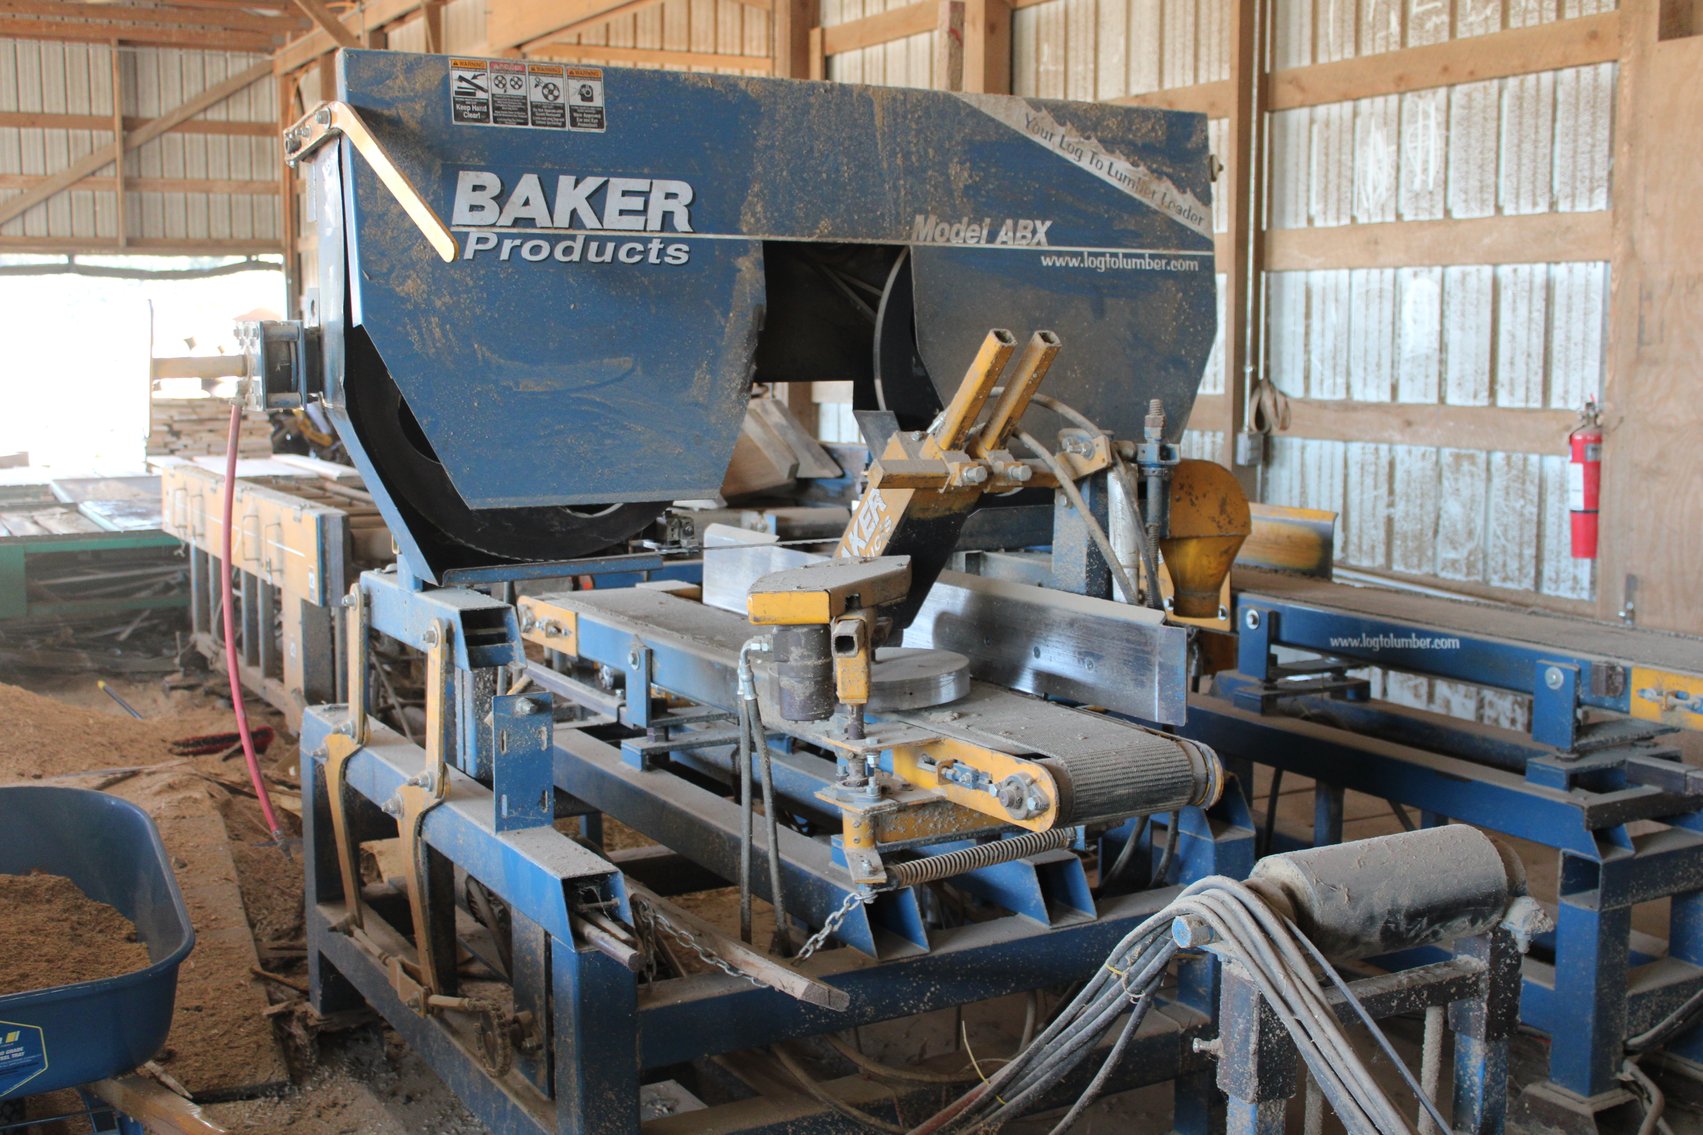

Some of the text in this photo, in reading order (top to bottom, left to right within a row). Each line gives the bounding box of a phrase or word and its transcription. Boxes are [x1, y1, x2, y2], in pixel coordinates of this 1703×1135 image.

[1024, 112, 1054, 142] Your
[1059, 134, 1084, 162] Log
[1088, 151, 1103, 171] To
[1160, 192, 1205, 226] Leader
[452, 170, 694, 232] BAKER
[911, 214, 1053, 247] Model ABX
[463, 232, 690, 266] Products
[1040, 251, 1200, 273] www.logtolumber.com
[1329, 632, 1460, 651] www.logtolumber.com
